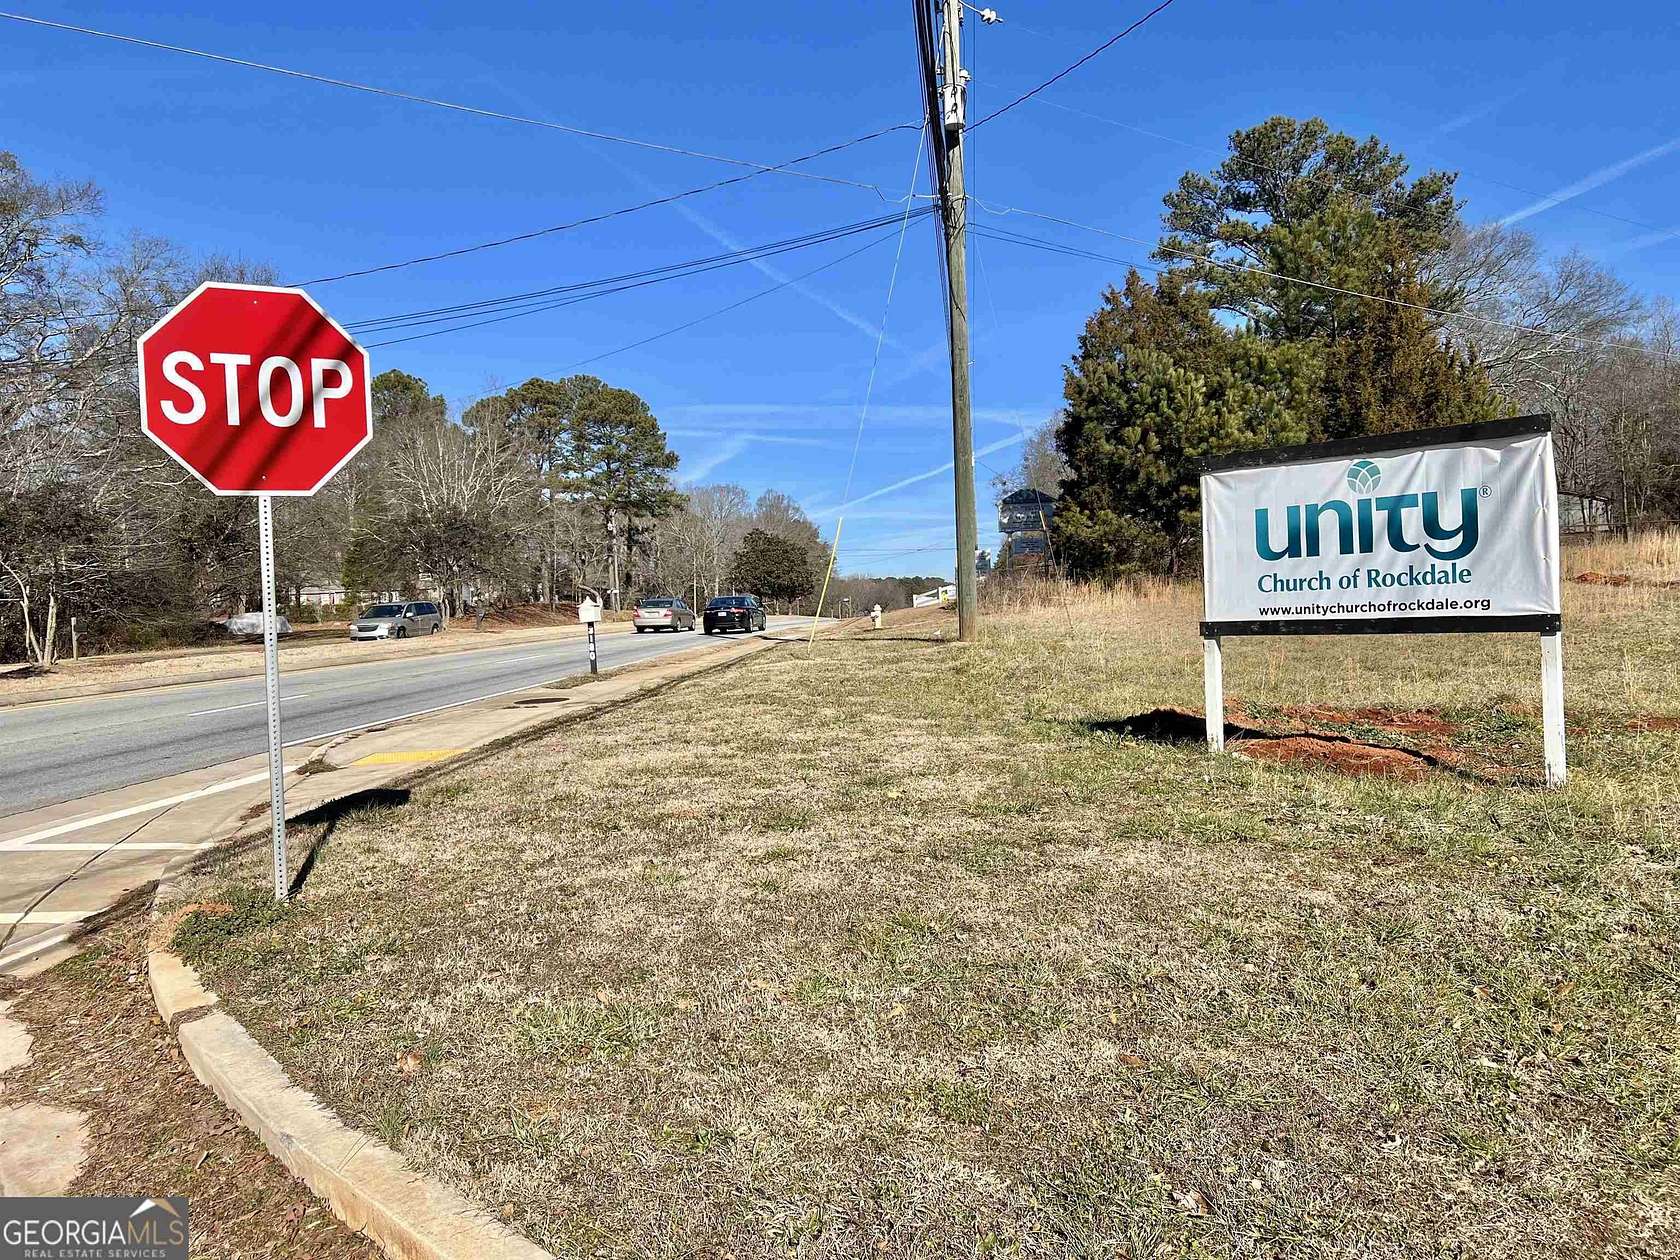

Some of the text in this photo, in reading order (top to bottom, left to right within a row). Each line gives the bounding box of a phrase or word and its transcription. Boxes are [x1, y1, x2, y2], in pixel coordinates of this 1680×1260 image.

[160, 350, 353, 428] STOP
[1255, 487, 1479, 561] unity
[1257, 562, 1472, 593] Church of Rockdale
[1259, 598, 1491, 616] www.unitychurchofrockdale.org
